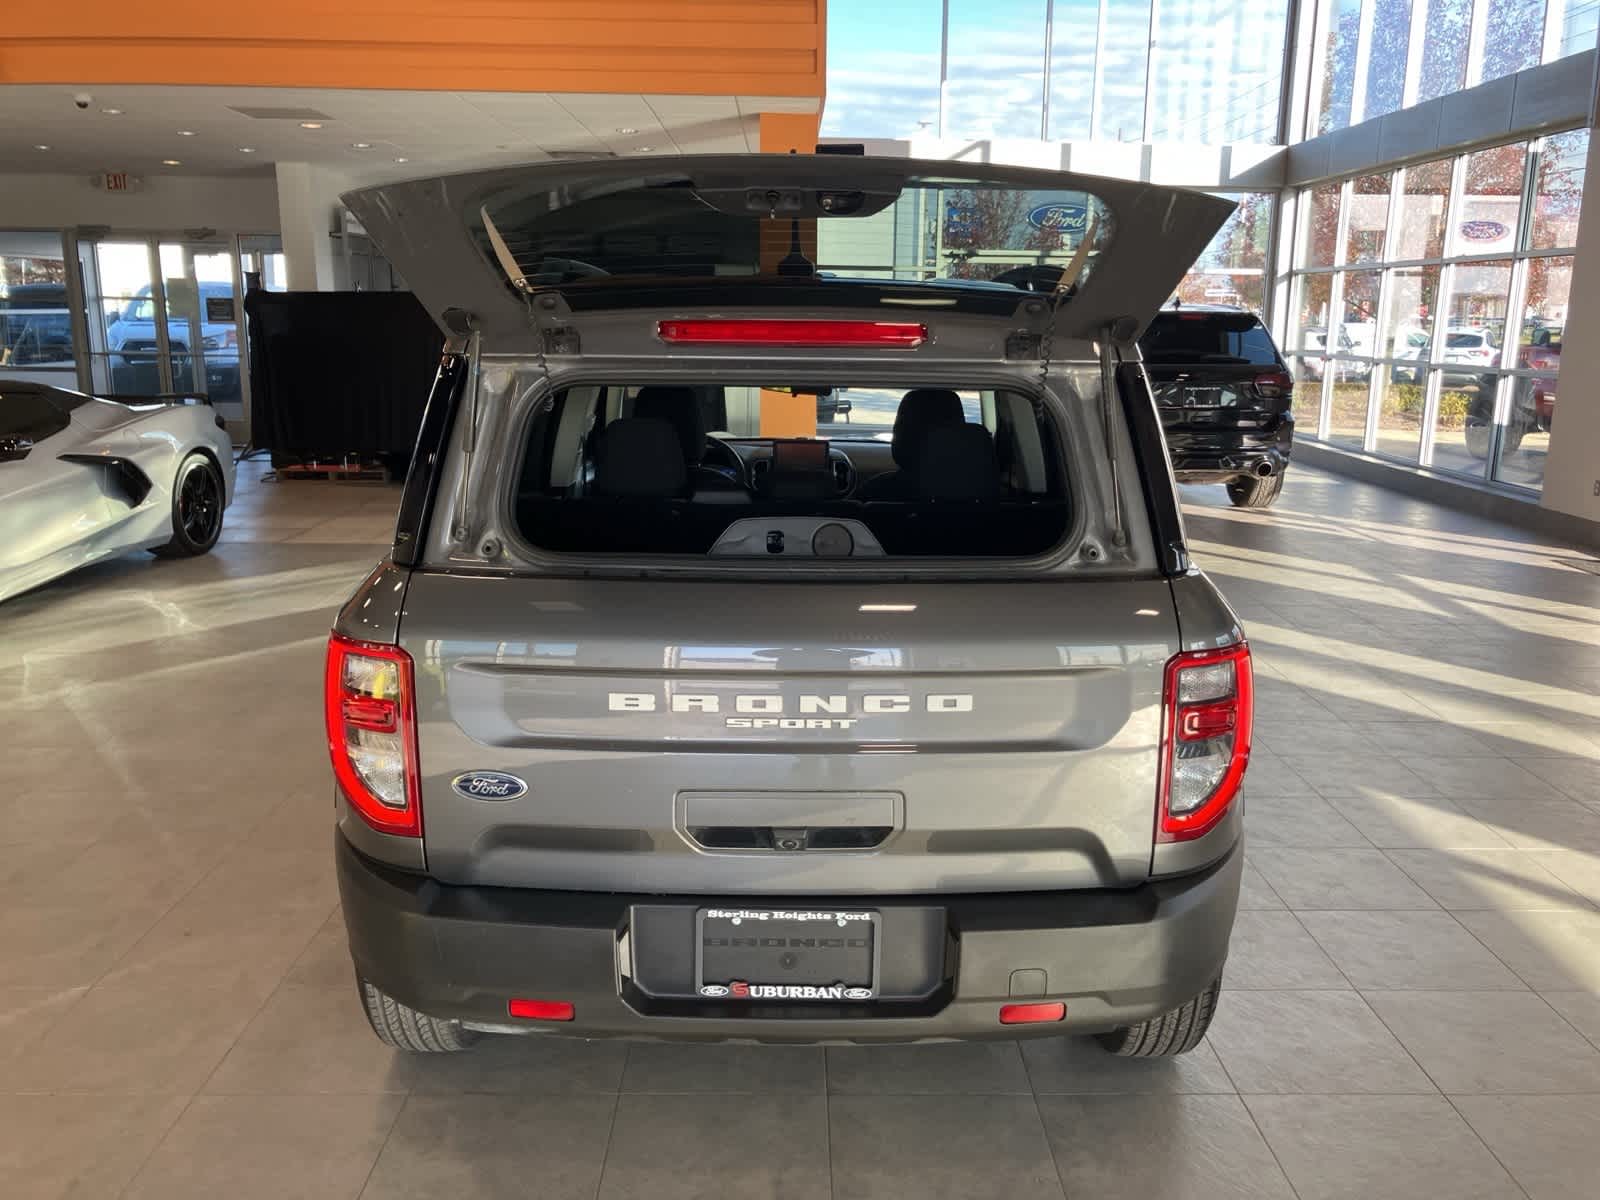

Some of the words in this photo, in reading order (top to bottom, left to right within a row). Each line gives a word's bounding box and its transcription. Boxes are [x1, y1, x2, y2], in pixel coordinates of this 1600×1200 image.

[106, 174, 128, 190] EXIT
[1042, 207, 1087, 228] Ford
[608, 693, 974, 714] BRONCO
[725, 717, 858, 729] SPORT
[707, 910, 769, 920] Sterling
[772, 911, 832, 921] Heights
[835, 912, 871, 921] Ford
[731, 983, 842, 999] SUBURBAN
